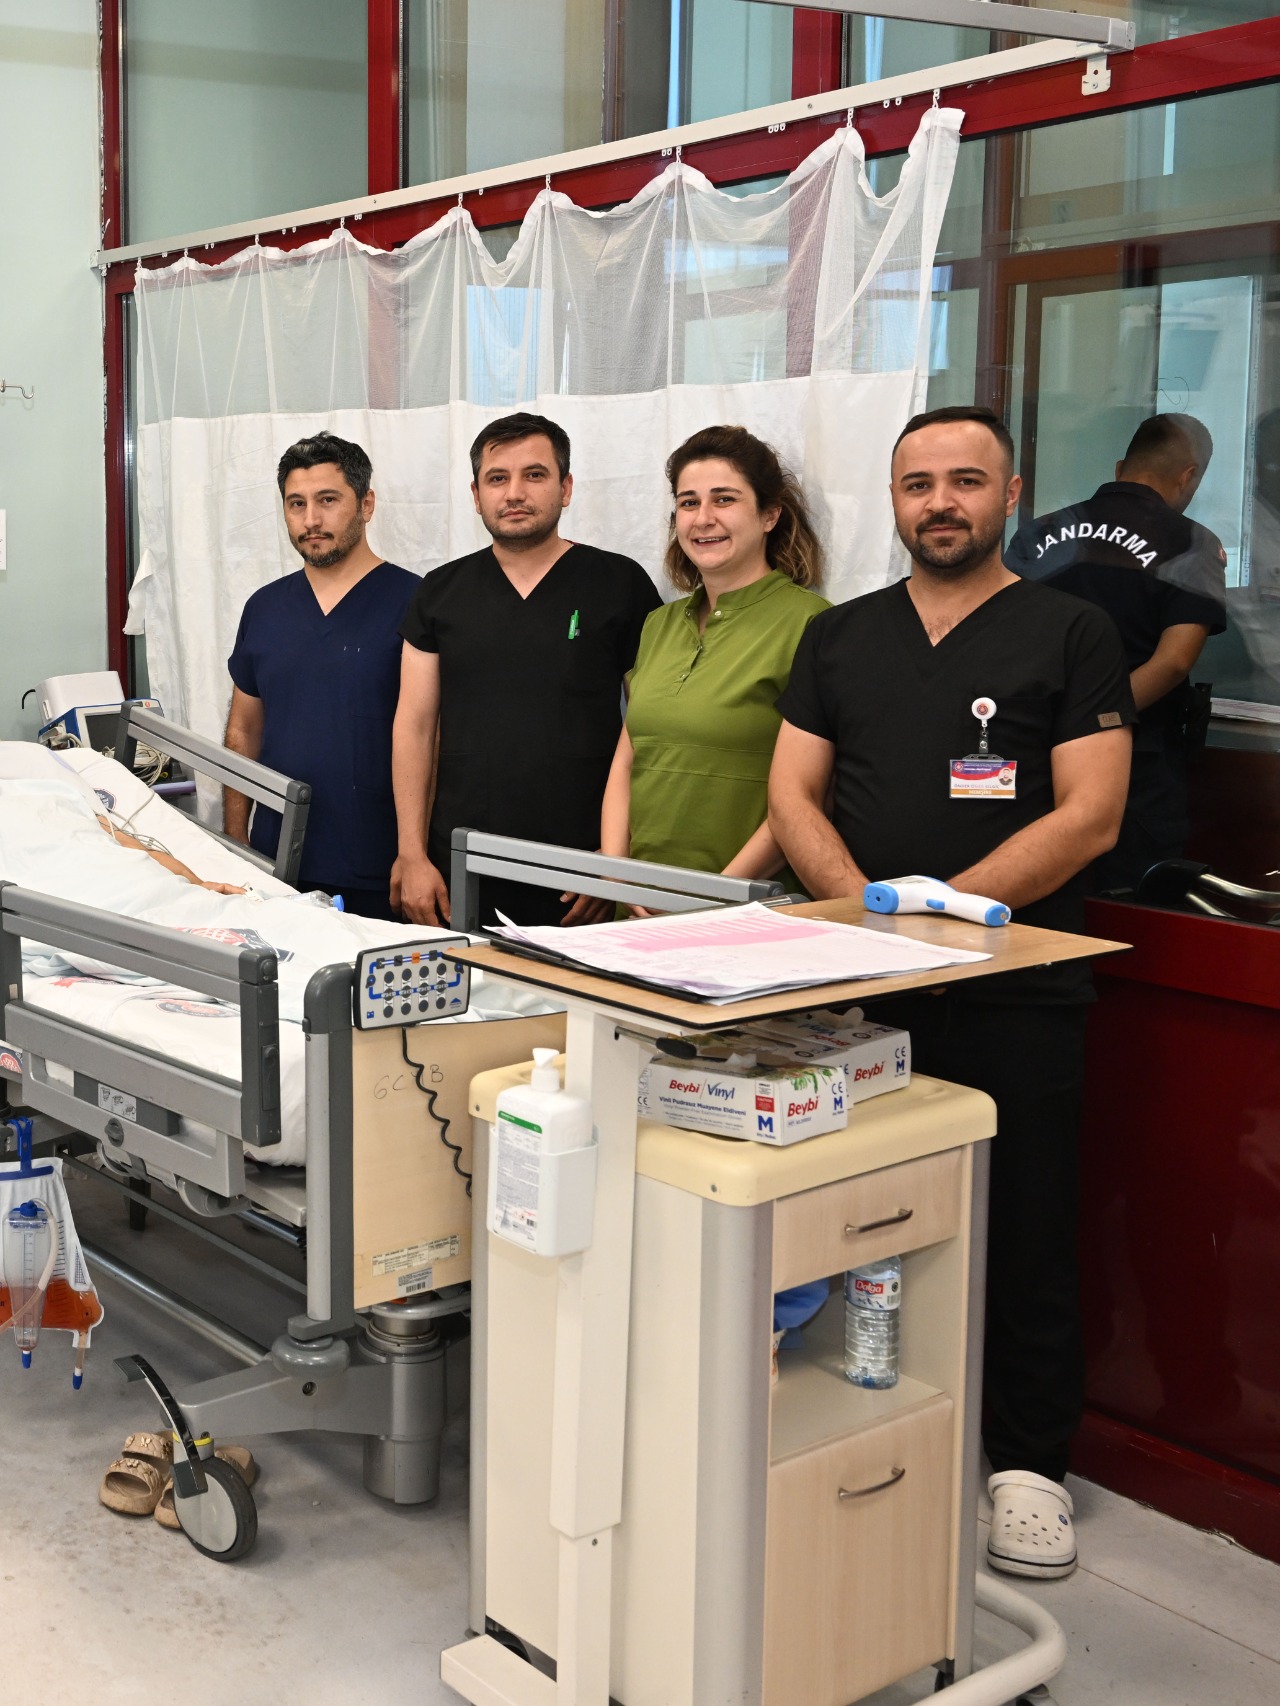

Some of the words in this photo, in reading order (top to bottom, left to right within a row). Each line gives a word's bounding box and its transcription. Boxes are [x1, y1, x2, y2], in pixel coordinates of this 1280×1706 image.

[1036, 522, 1159, 569] JANDARMA
[853, 1061, 885, 1082] Beybi
[896, 1058, 906, 1073] M
[669, 1079, 702, 1094] Beybi
[707, 1081, 736, 1101] Vinyl
[831, 1081, 844, 1095] CE
[787, 1095, 819, 1118] Beybi
[833, 1095, 844, 1111] M
[757, 1114, 774, 1133] M
